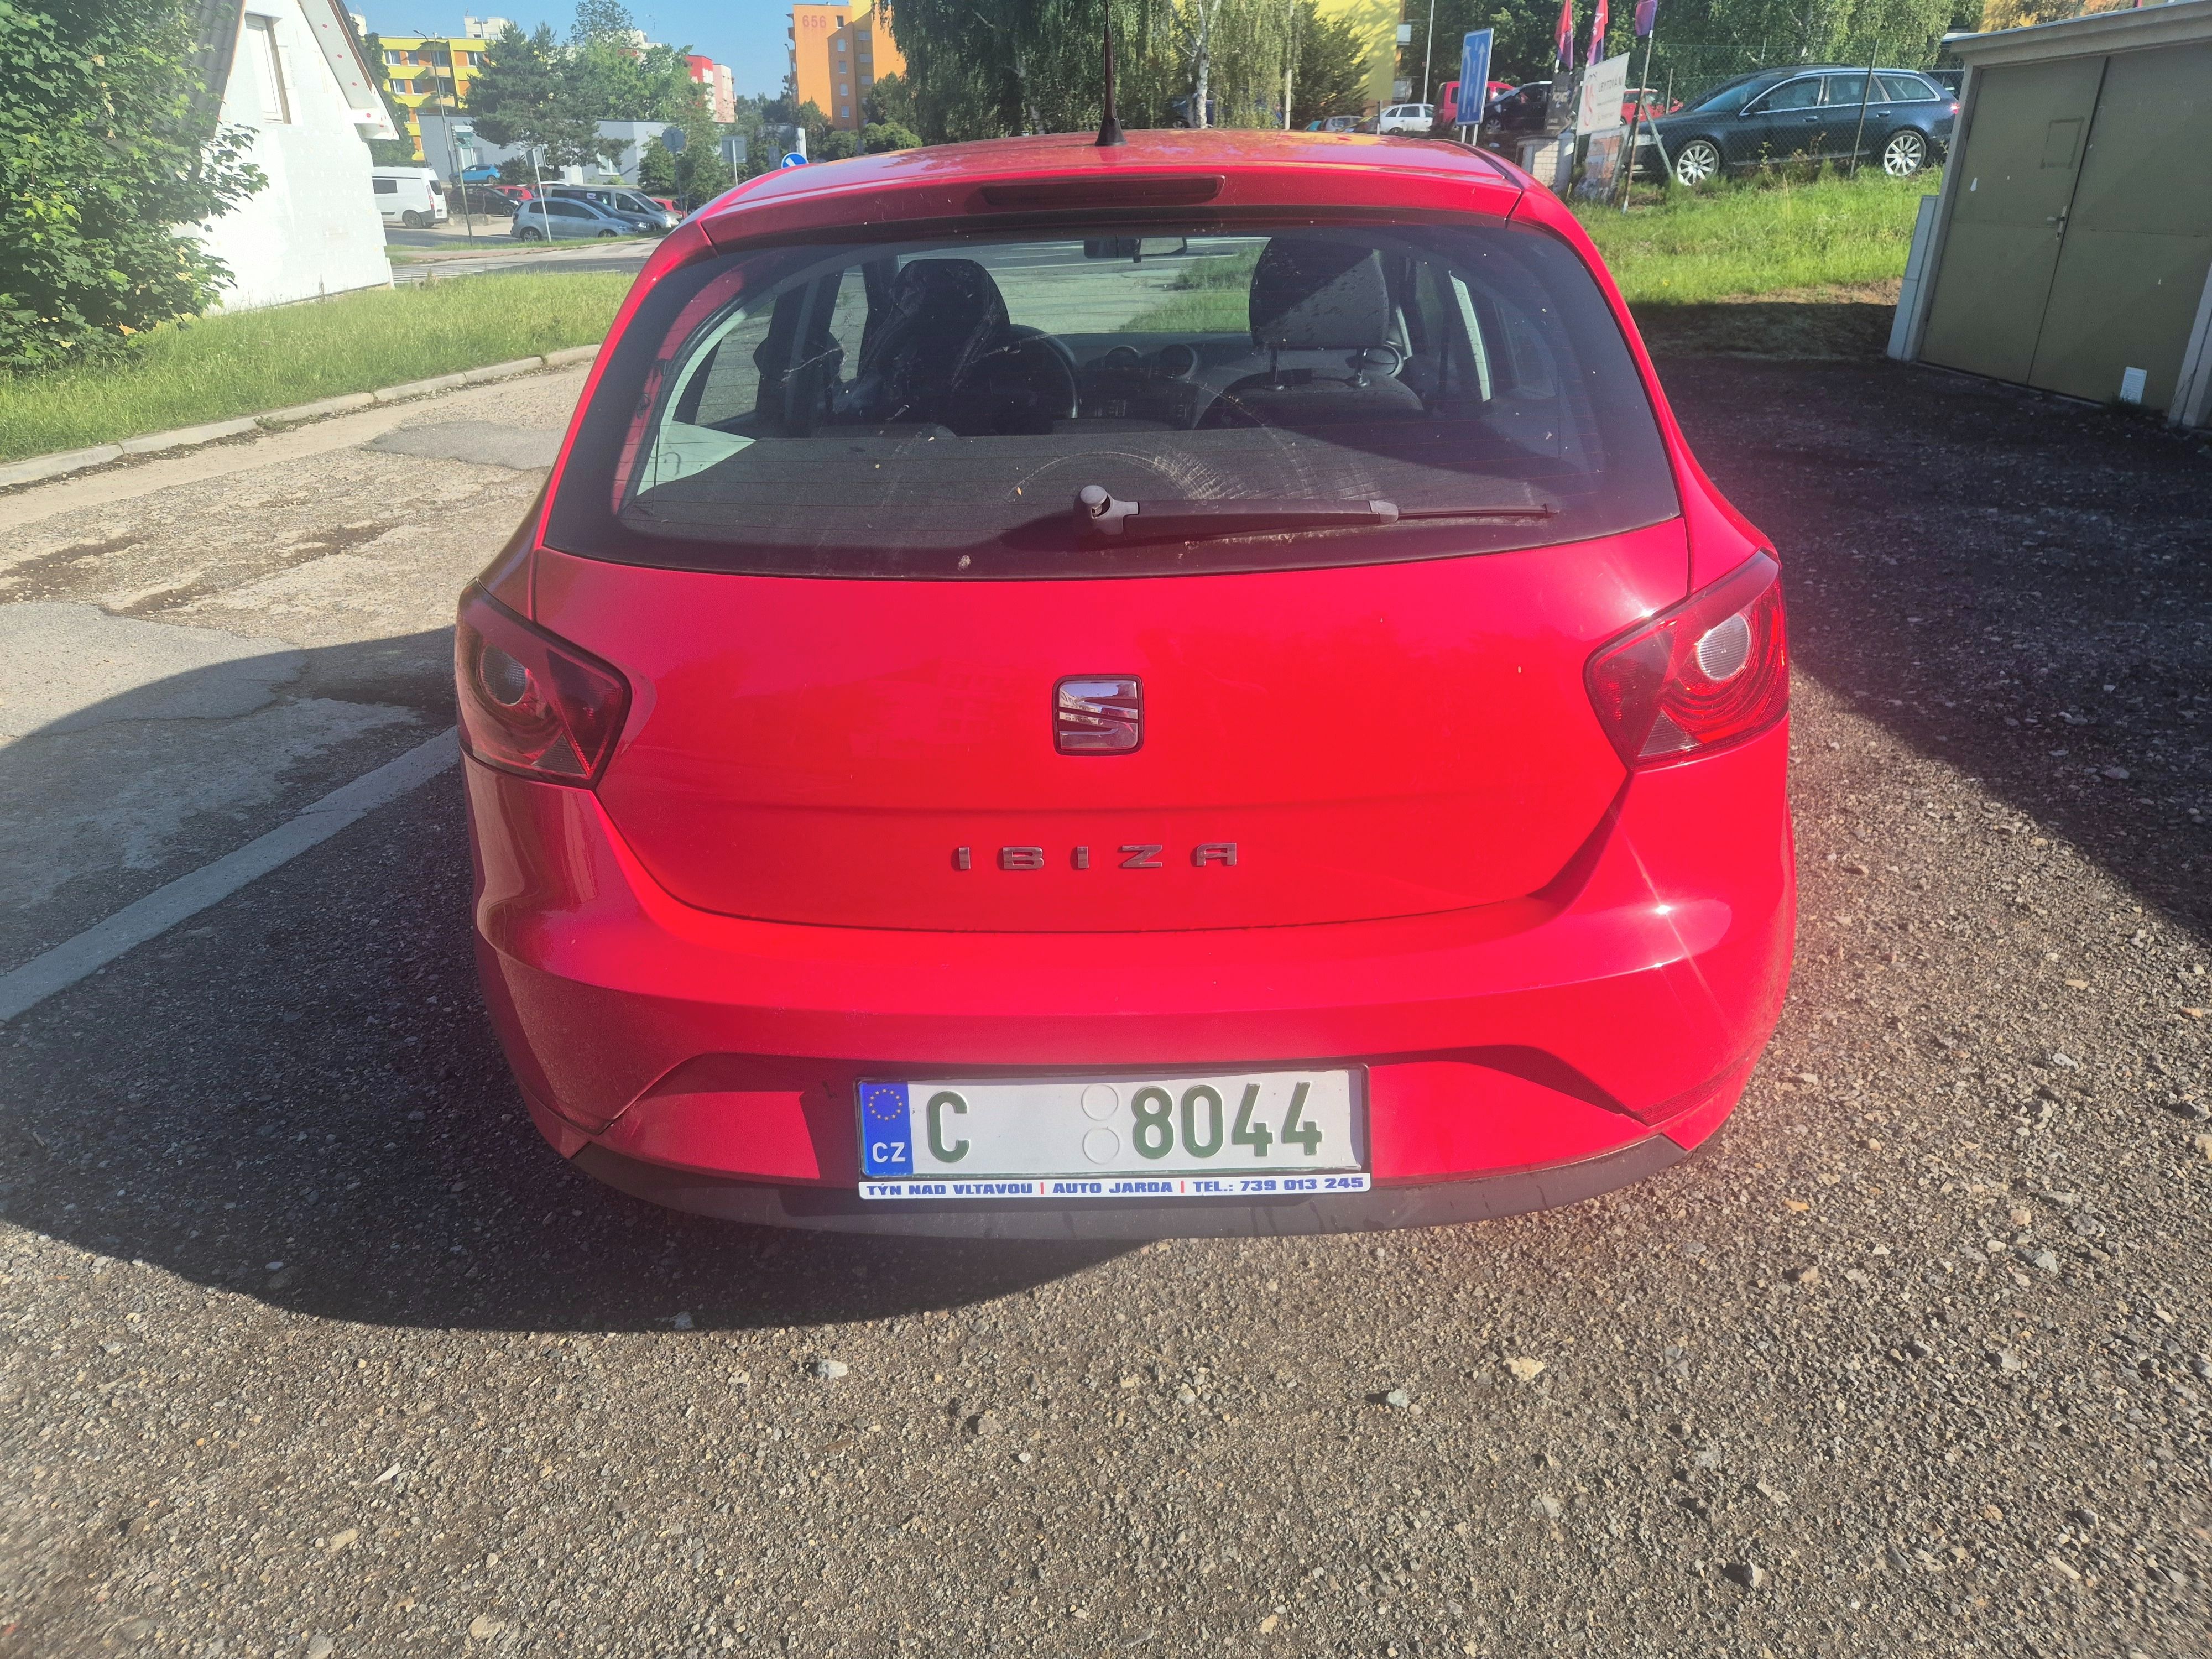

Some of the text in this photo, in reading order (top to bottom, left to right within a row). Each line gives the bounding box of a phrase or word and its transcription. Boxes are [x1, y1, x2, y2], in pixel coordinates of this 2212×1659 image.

[802, 15, 826, 28] 656
[957, 842, 1238, 870] IBIZA
[927, 1082, 1323, 1163] C 8044
[872, 1141, 906, 1163] CZ
[866, 1176, 1364, 1196] TÝN NAD VLTAVOU AUTO JARDA TEL.: 739 013 245
